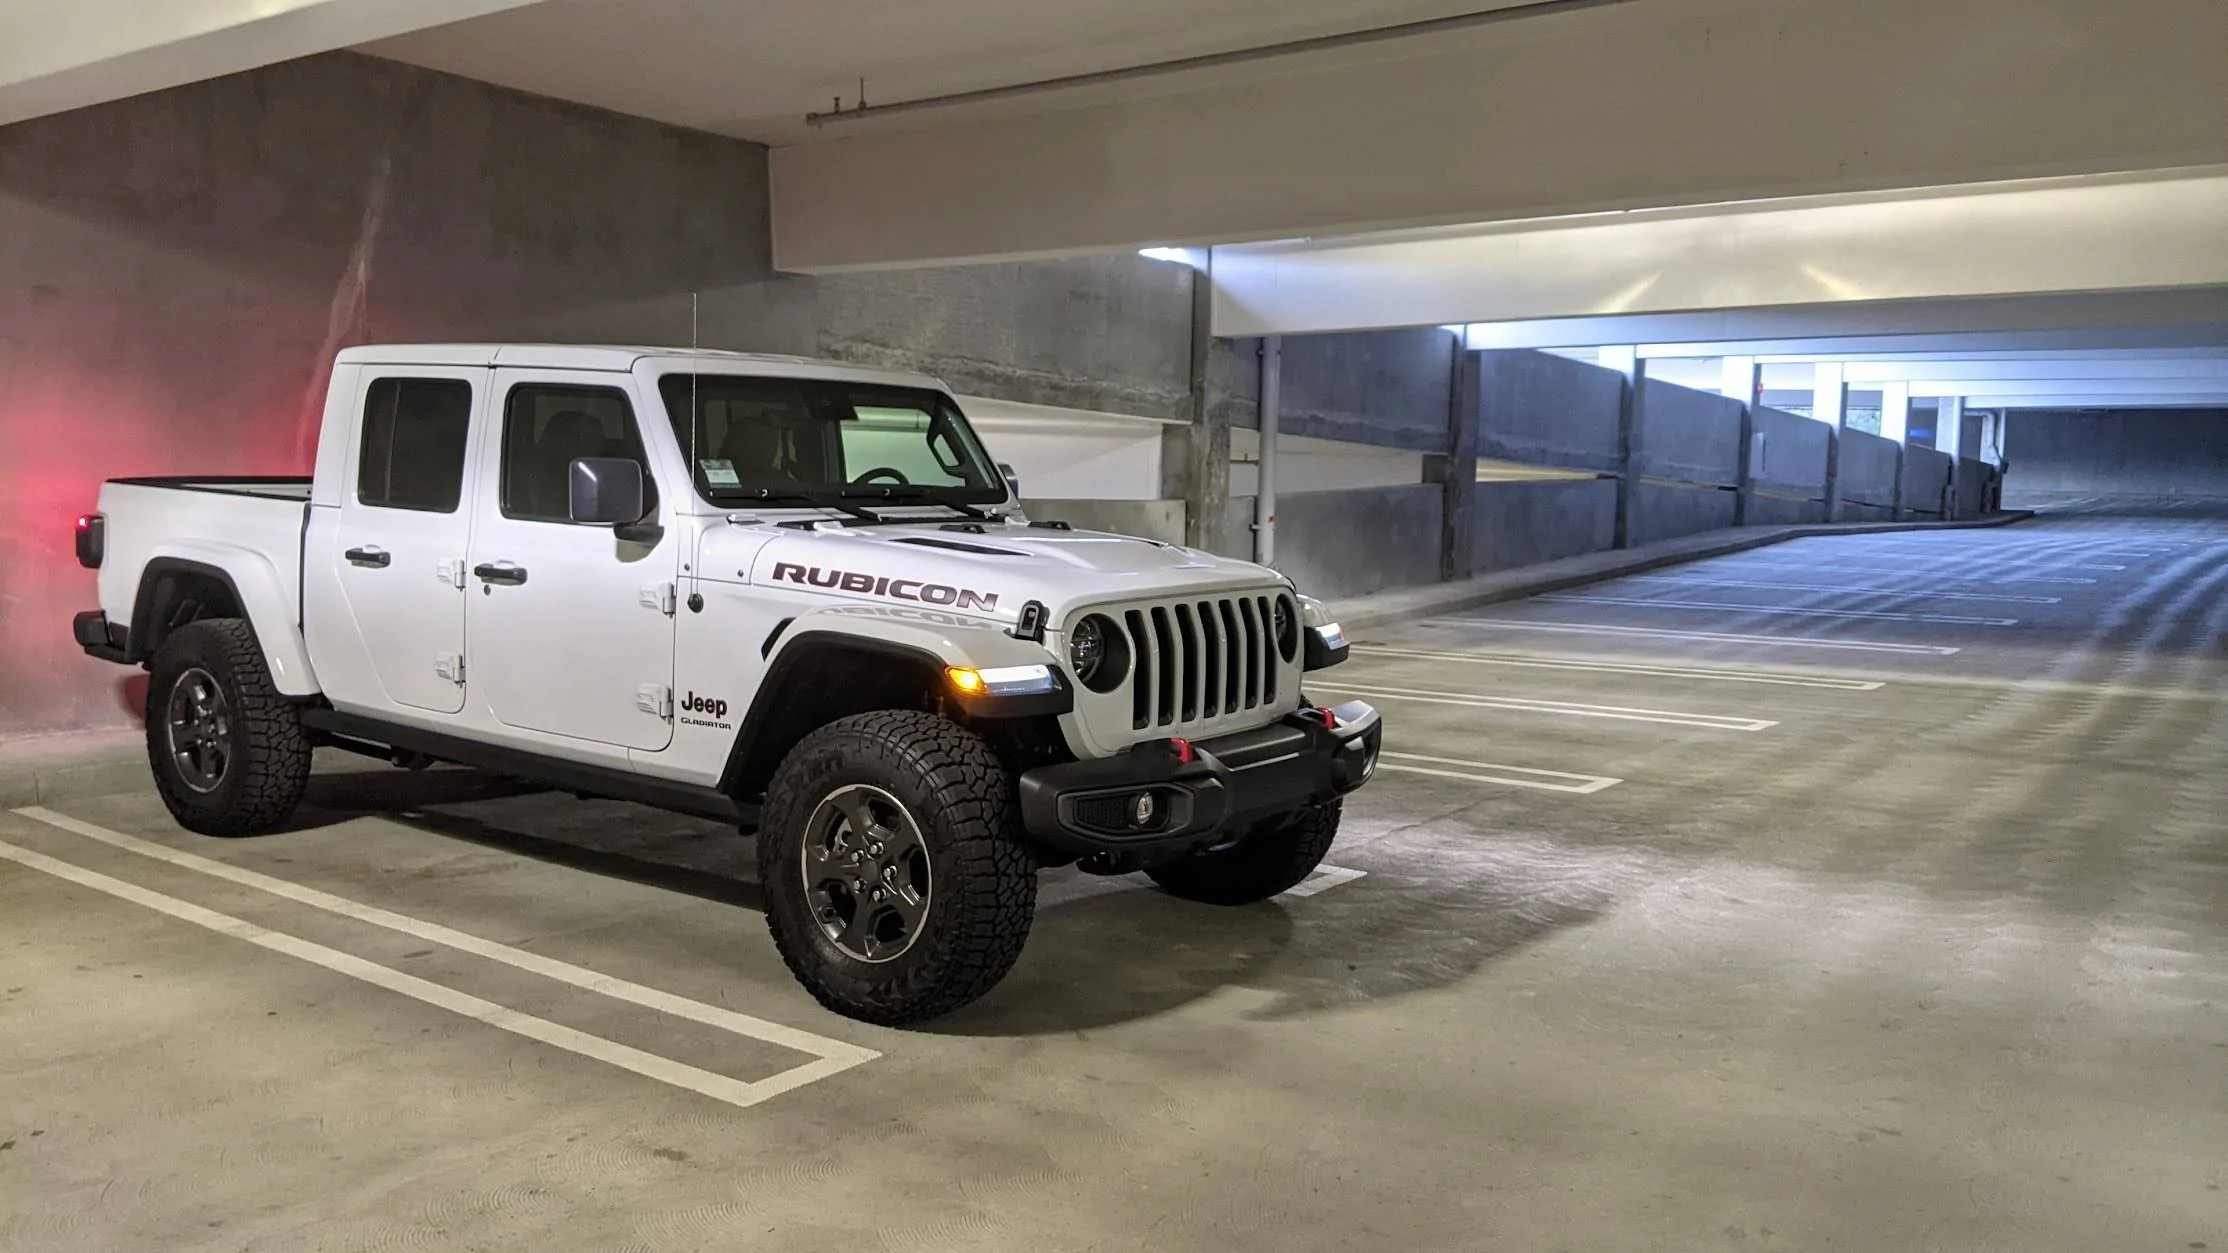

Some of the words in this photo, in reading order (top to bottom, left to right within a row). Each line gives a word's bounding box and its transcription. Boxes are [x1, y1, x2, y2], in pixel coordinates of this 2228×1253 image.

[772, 562, 999, 612] RUBICON
[681, 691, 728, 719] Jeep
[680, 717, 732, 730] GLADIATOR
